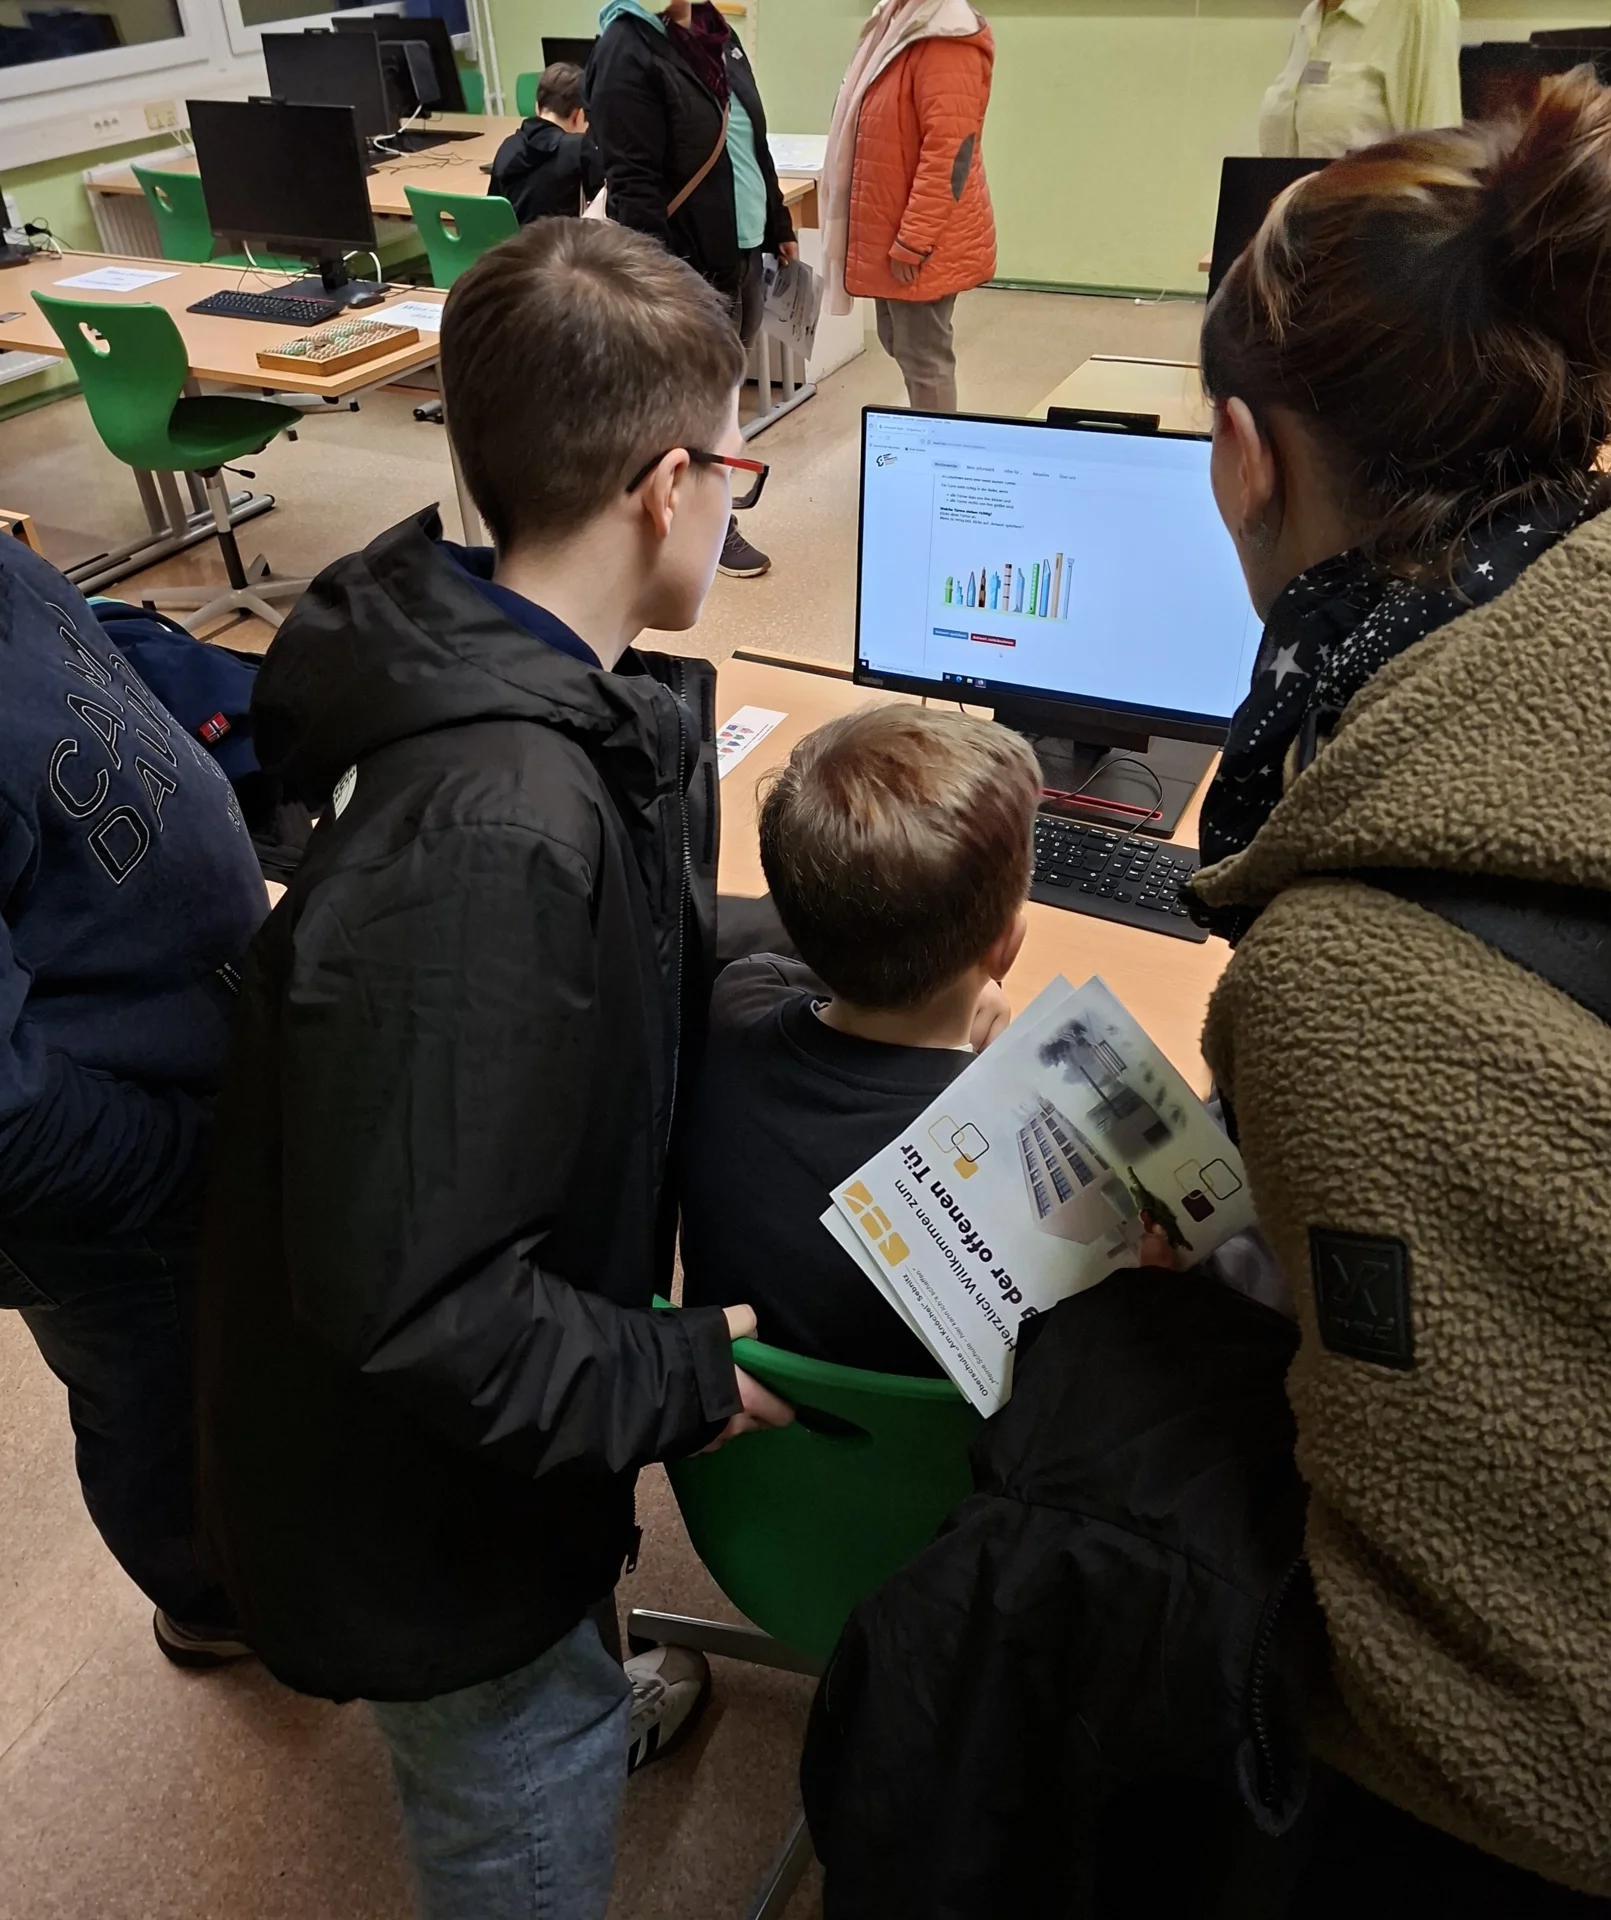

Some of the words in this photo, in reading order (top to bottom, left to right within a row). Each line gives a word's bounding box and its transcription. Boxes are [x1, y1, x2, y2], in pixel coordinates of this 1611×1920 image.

[45, 601, 127, 818] CAM
[900, 1144, 931, 1184] Tür
[894, 1179, 918, 1209] zum
[930, 1180, 993, 1263] offenen
[915, 1208, 977, 1295] Willkommen
[902, 1274, 923, 1302] Sebnitz
[990, 1267, 1023, 1305] der
[920, 1303, 947, 1336] Knöchel“
[944, 1310, 957, 1327] kann
[954, 1326, 965, 1339] hier
[975, 1291, 1019, 1352] Herzlich
[966, 1342, 983, 1365] Schule
[957, 1352, 989, 1397] Oberschule
